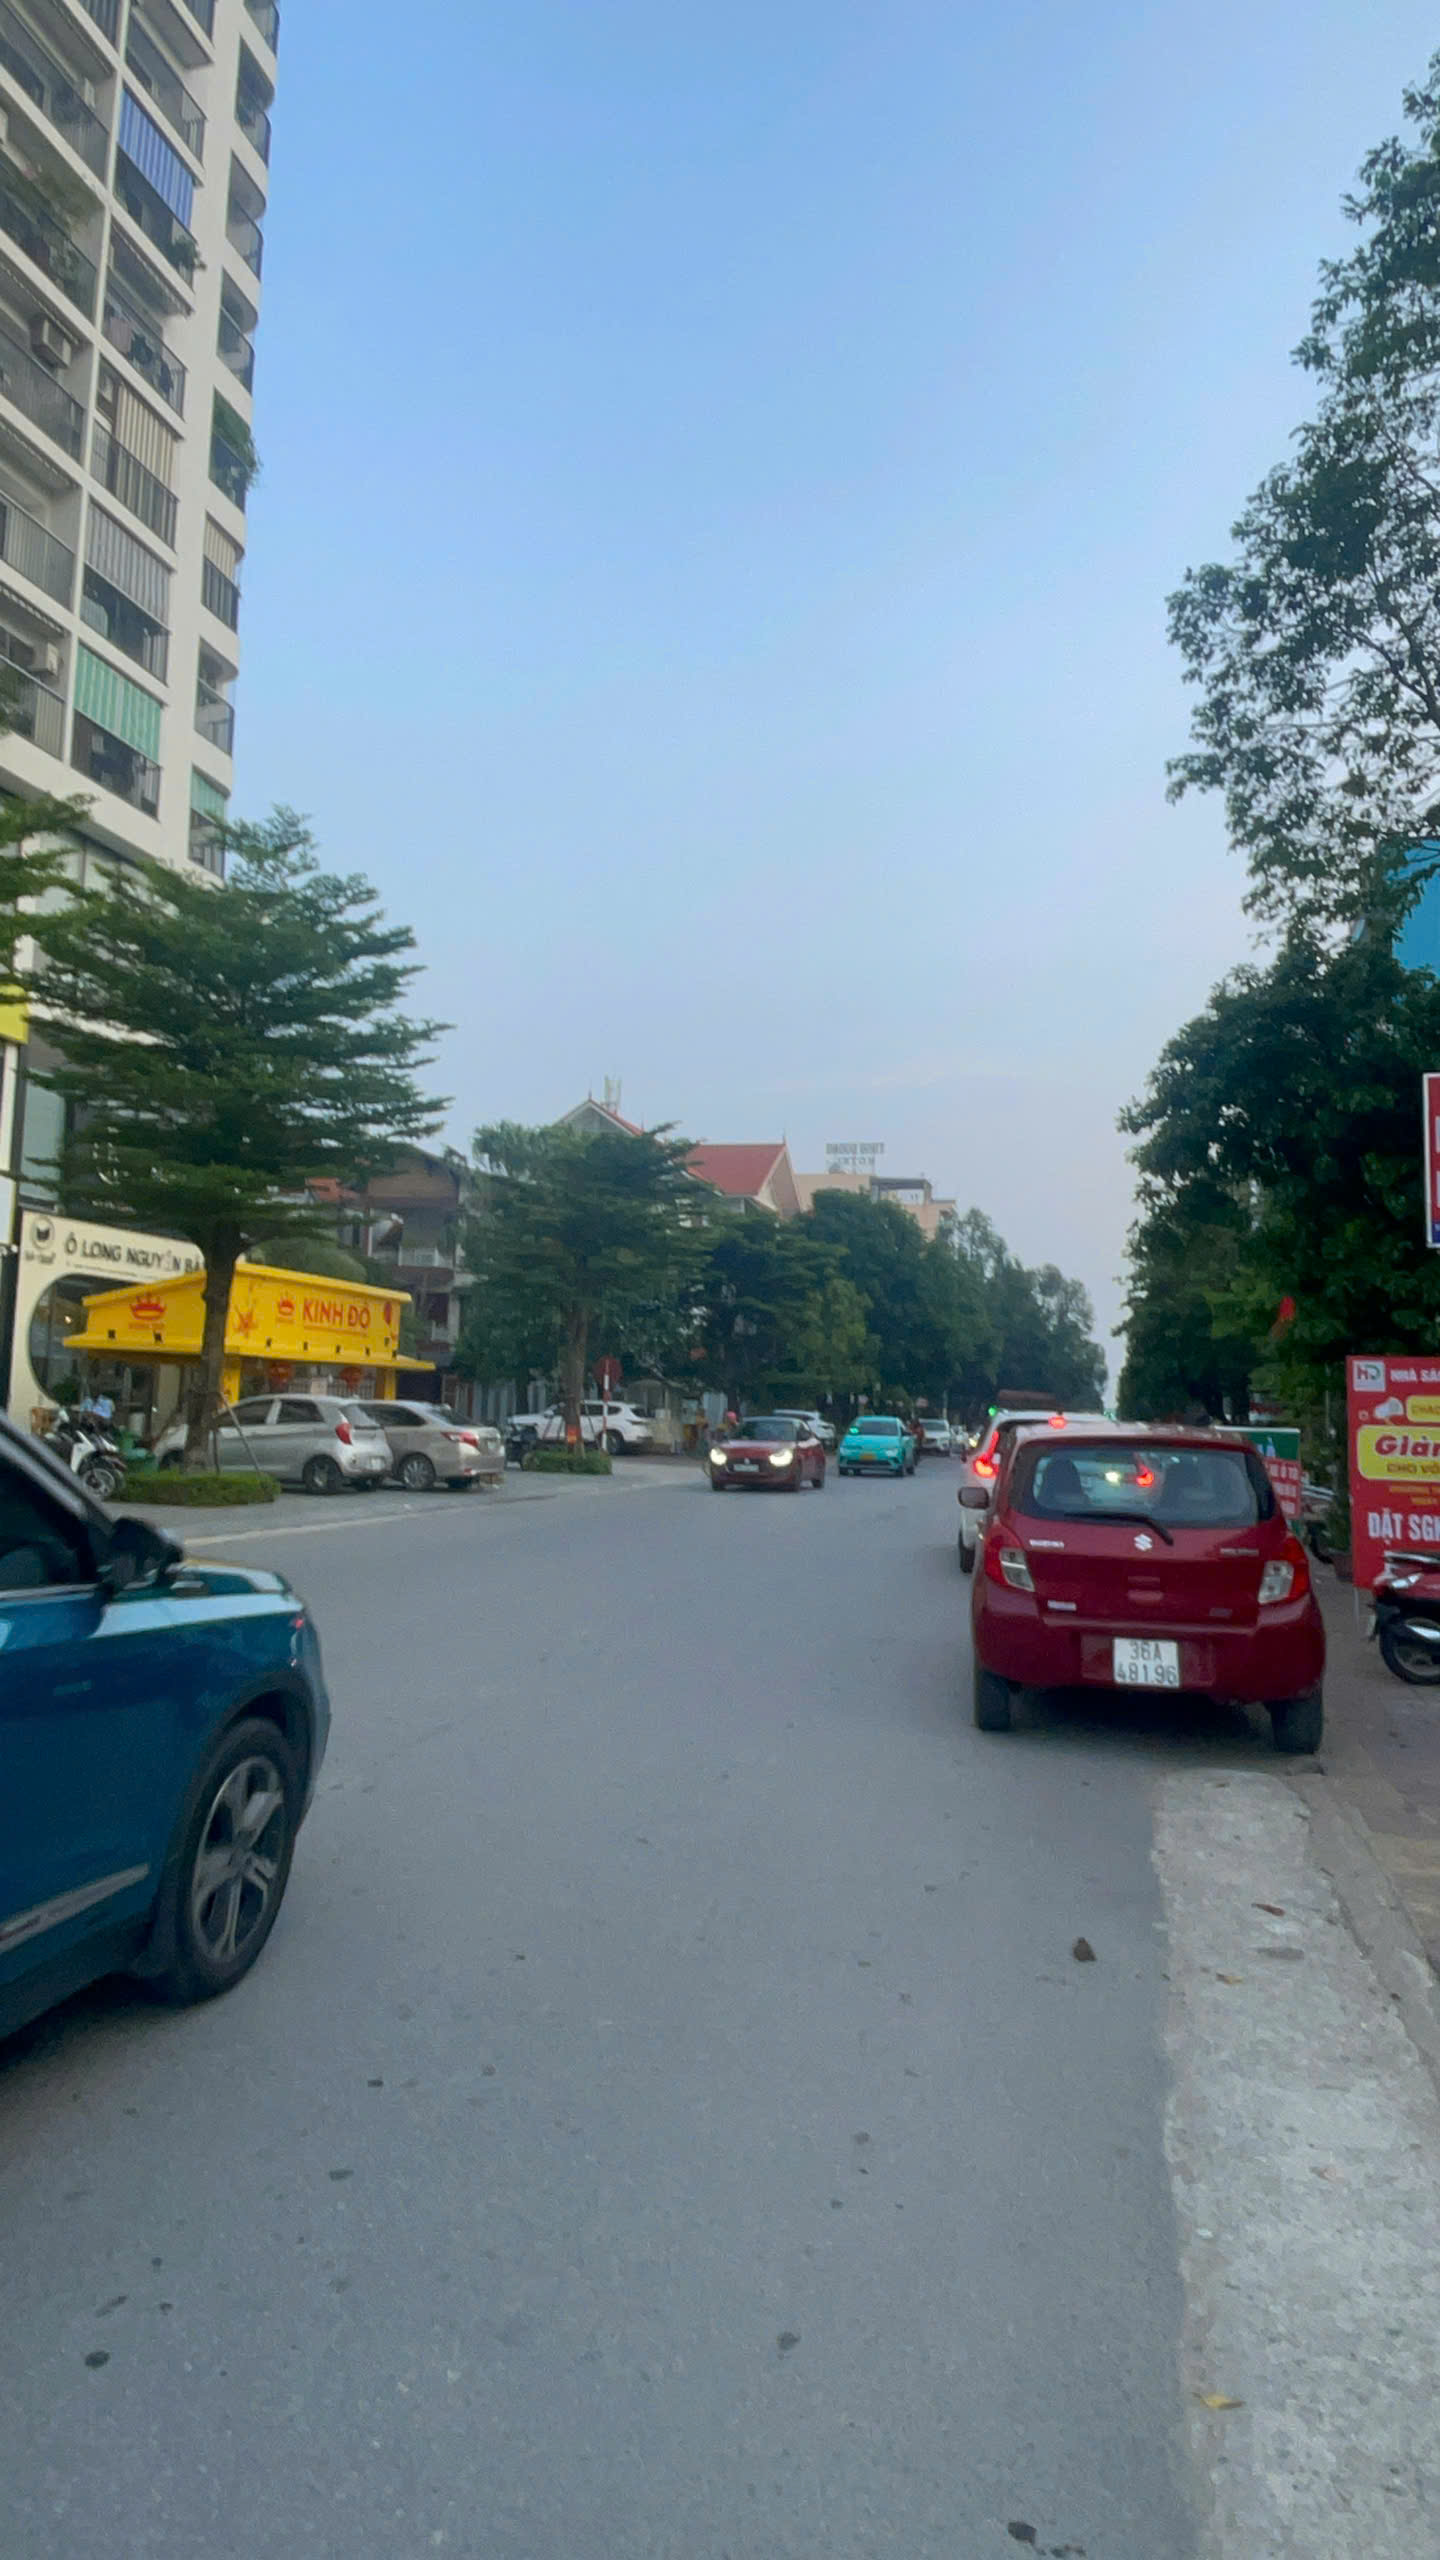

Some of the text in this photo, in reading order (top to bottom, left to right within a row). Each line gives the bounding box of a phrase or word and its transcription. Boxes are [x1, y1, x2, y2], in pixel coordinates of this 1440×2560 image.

[82, 1240, 122, 1262] LONG
[303, 1297, 344, 1326] KINH
[1129, 1639, 1163, 1662] 36A
